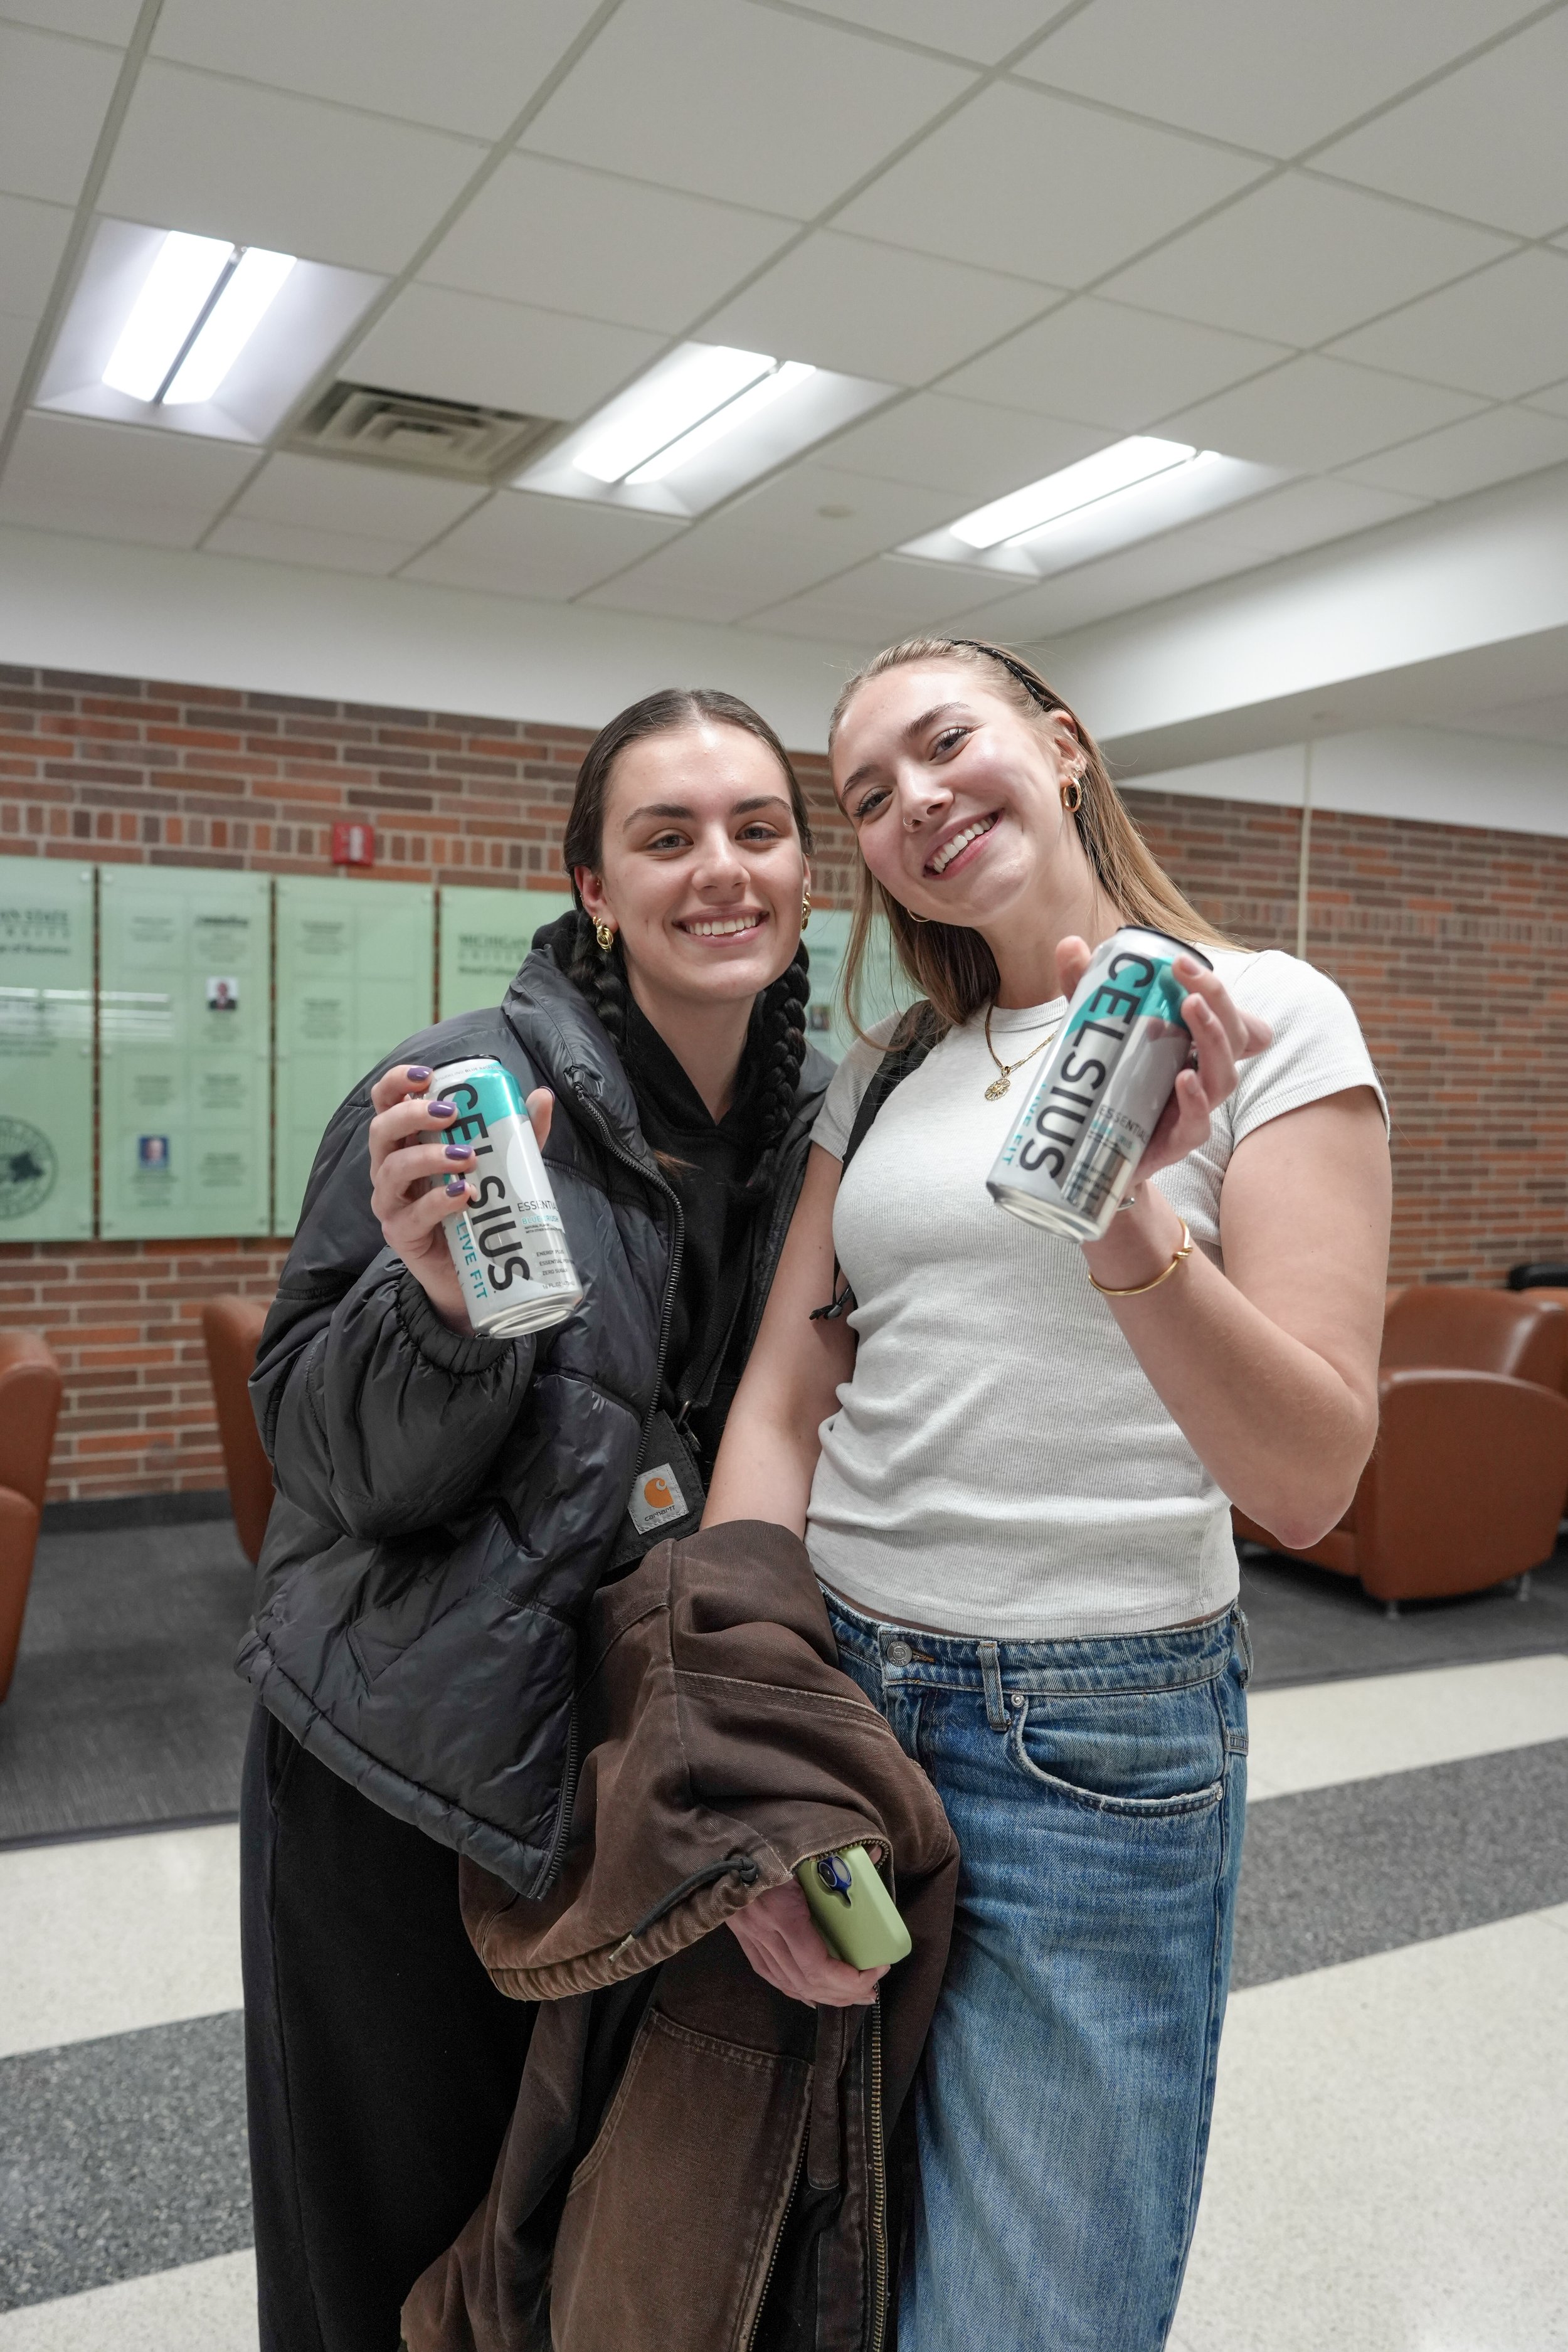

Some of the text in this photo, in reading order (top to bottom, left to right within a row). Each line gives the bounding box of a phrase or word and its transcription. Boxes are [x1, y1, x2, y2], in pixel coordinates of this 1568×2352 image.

[1019, 952, 1155, 1179] CELSIUS
[1023, 1083, 1046, 1127] IVE
[522, 1216, 541, 1225] BLUE
[456, 1221, 477, 1266] LIVE
[470, 1269, 488, 1298] FIT
[645, 1505, 675, 1522] carhartt
